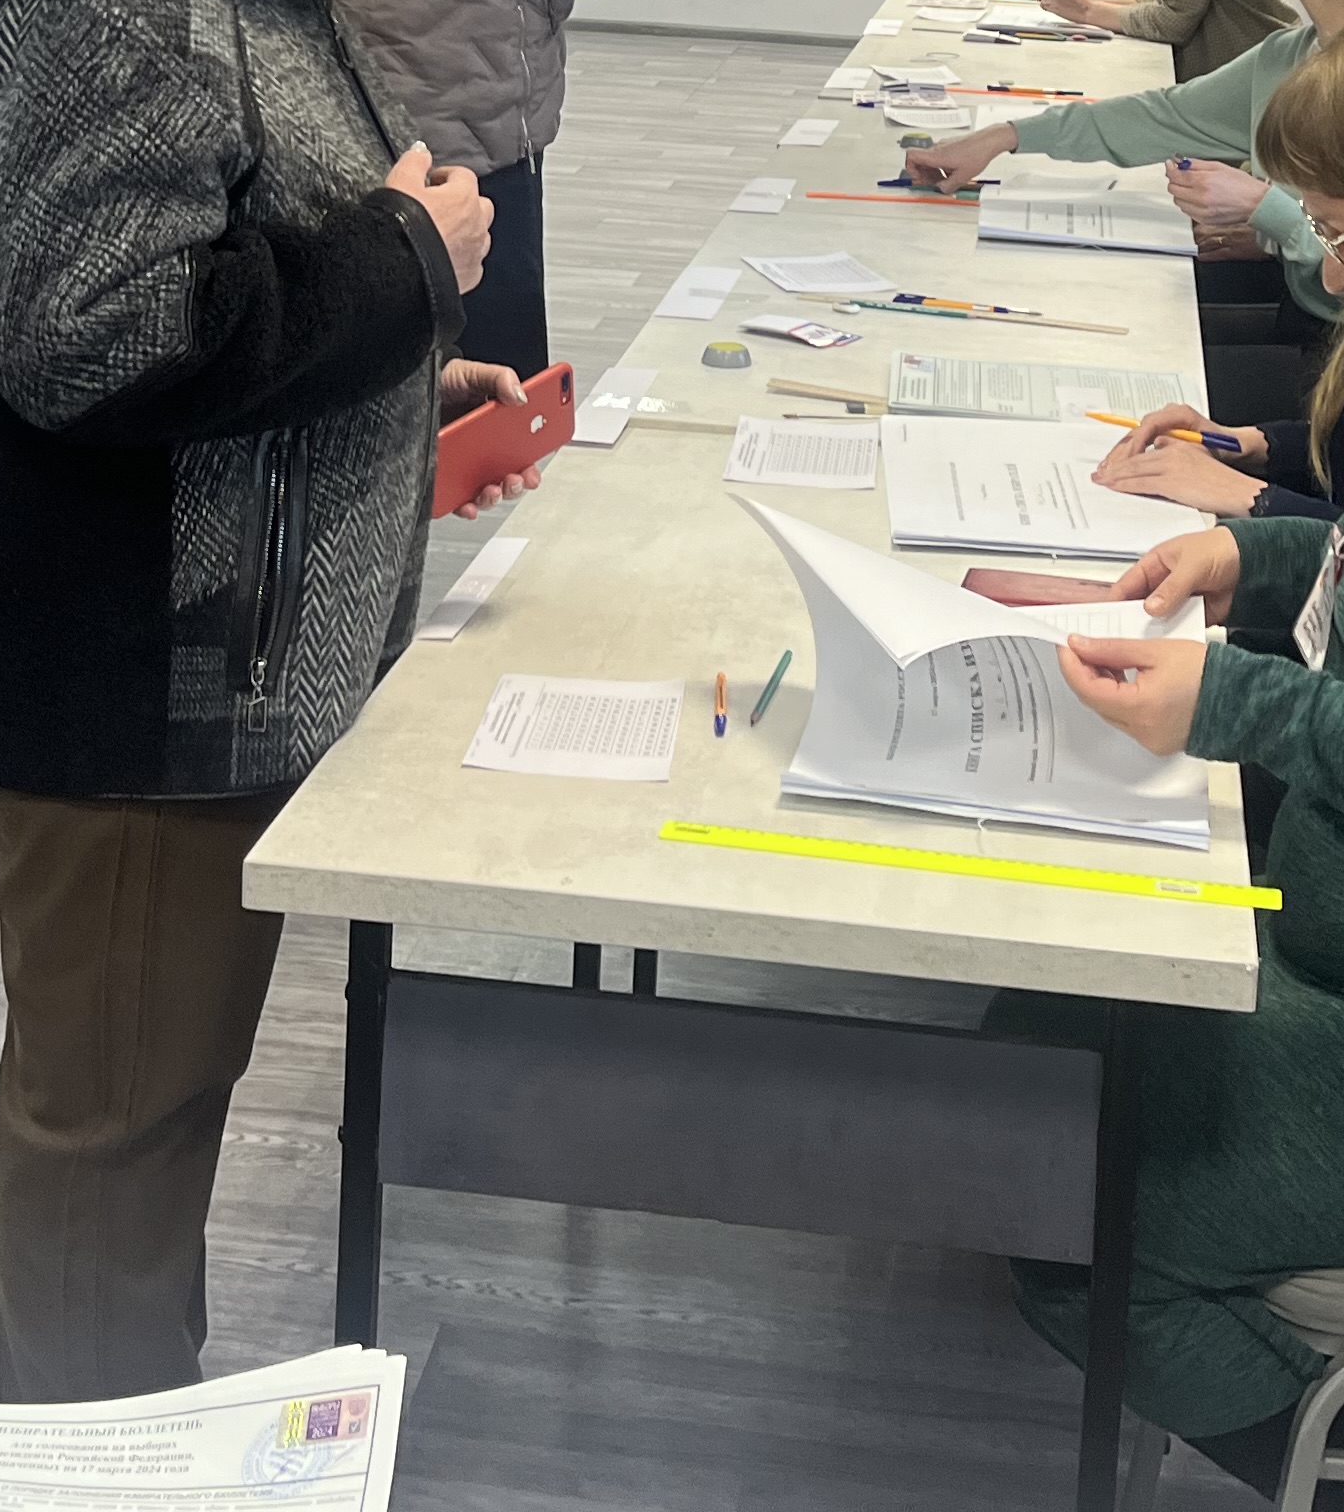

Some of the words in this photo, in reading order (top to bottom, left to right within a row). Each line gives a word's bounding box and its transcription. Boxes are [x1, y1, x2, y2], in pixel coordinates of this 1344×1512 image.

[119, 1420, 204, 1436] БЮЛЛЕТЕНЬ
[128, 1440, 178, 1452] выборах
[57, 1452, 125, 1463] Российской
[81, 1464, 95, 1474] 17
[97, 1465, 133, 1476] марта
[134, 1464, 162, 1475] 2024
